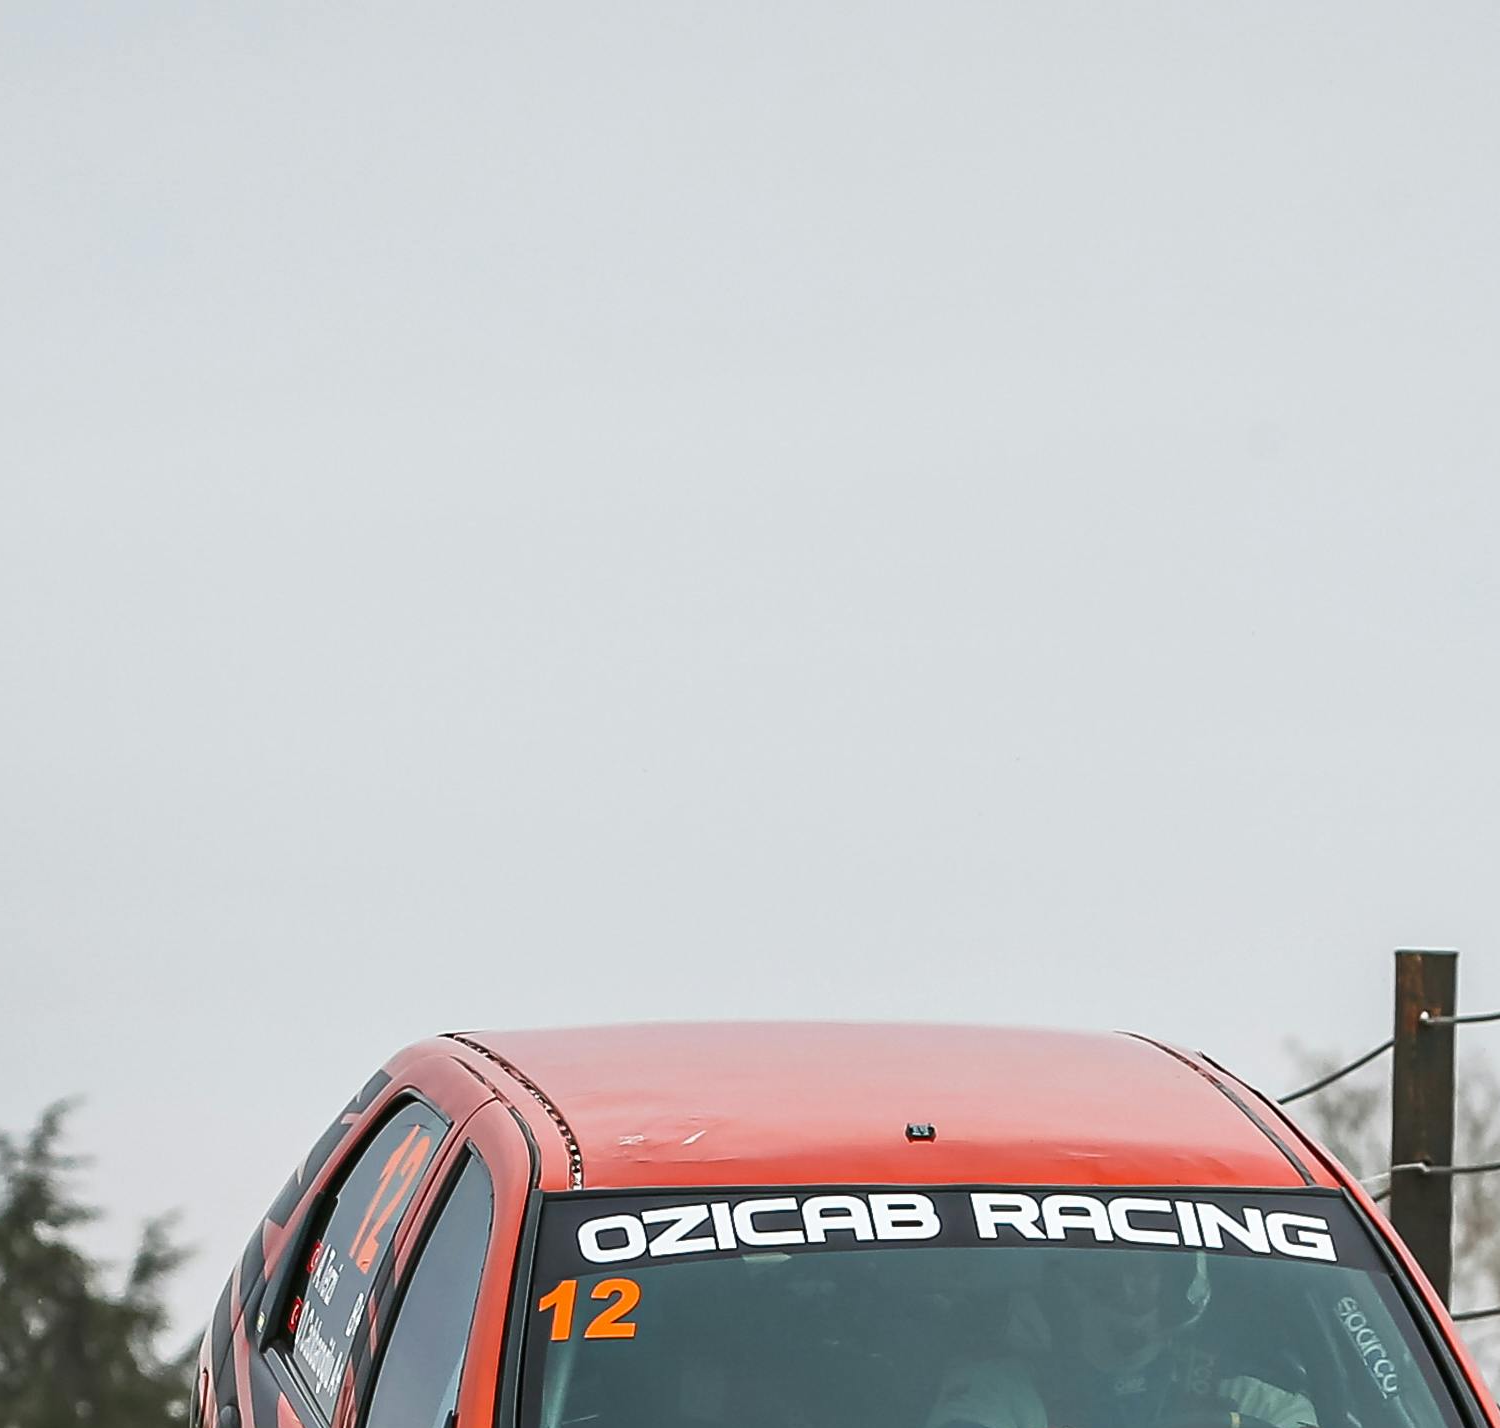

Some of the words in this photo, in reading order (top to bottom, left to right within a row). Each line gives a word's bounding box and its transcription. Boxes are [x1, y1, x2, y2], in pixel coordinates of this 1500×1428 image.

[349, 1124, 430, 1274] 12
[576, 1194, 941, 1264] OZICAB
[972, 1193, 1339, 1262] RACING
[538, 1278, 642, 1342] 12
